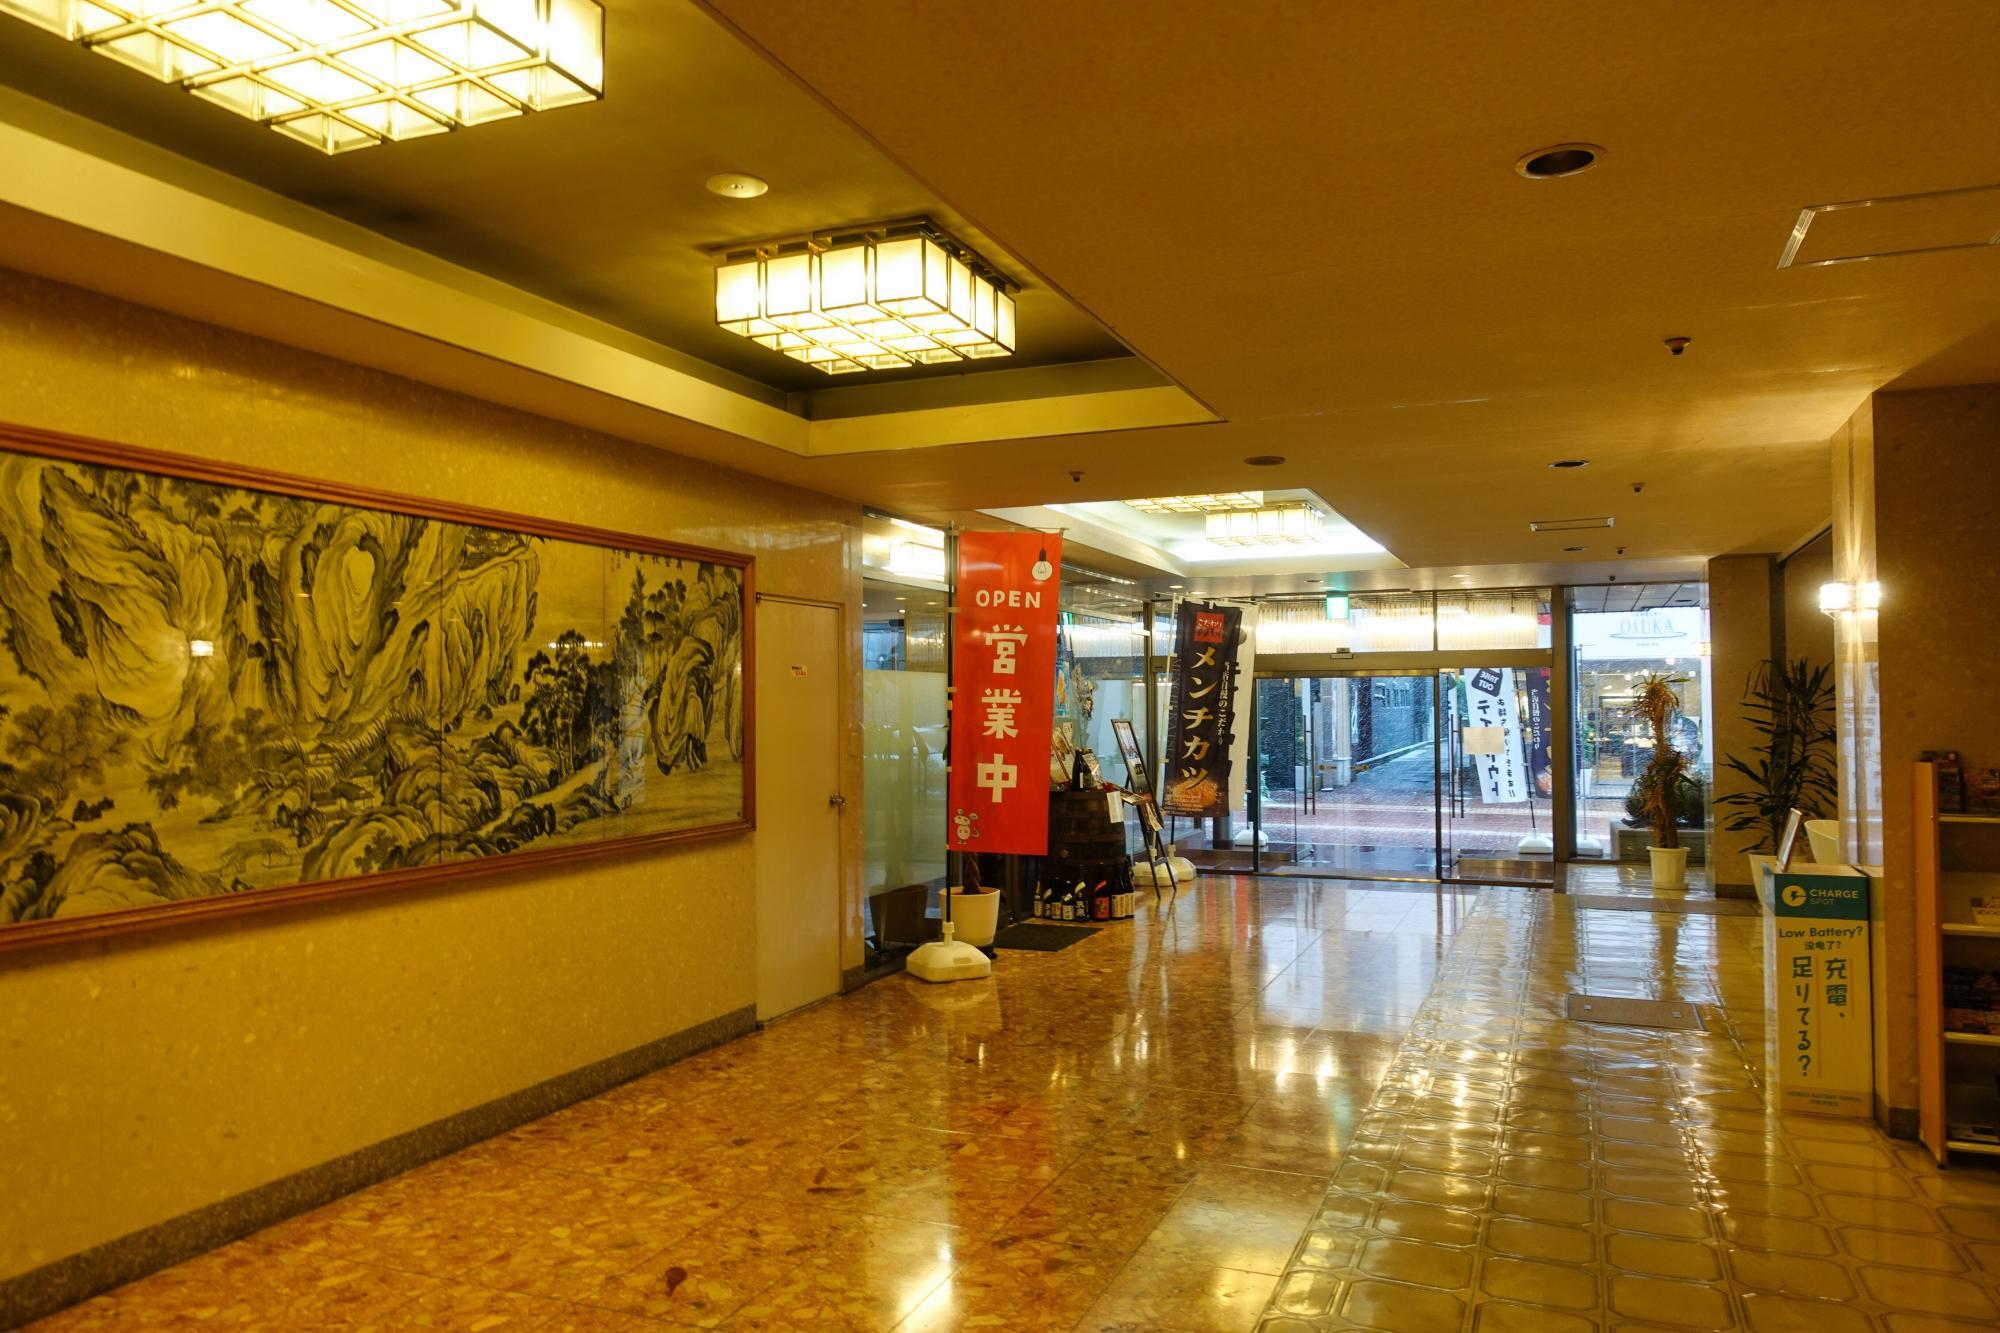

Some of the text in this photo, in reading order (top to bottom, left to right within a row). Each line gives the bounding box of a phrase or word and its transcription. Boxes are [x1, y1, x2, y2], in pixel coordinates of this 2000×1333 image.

[975, 589, 1041, 609] OPEN
[1198, 618, 1223, 628] こだわり
[977, 624, 1028, 803] 営業中
[1181, 646, 1218, 790] メンチカツ
[1809, 888, 1859, 899] CHARGE
[1778, 926, 1863, 939] Low Battery?
[1825, 957, 1848, 1018] 充電、
[1792, 955, 1813, 1077] 足りてる?
